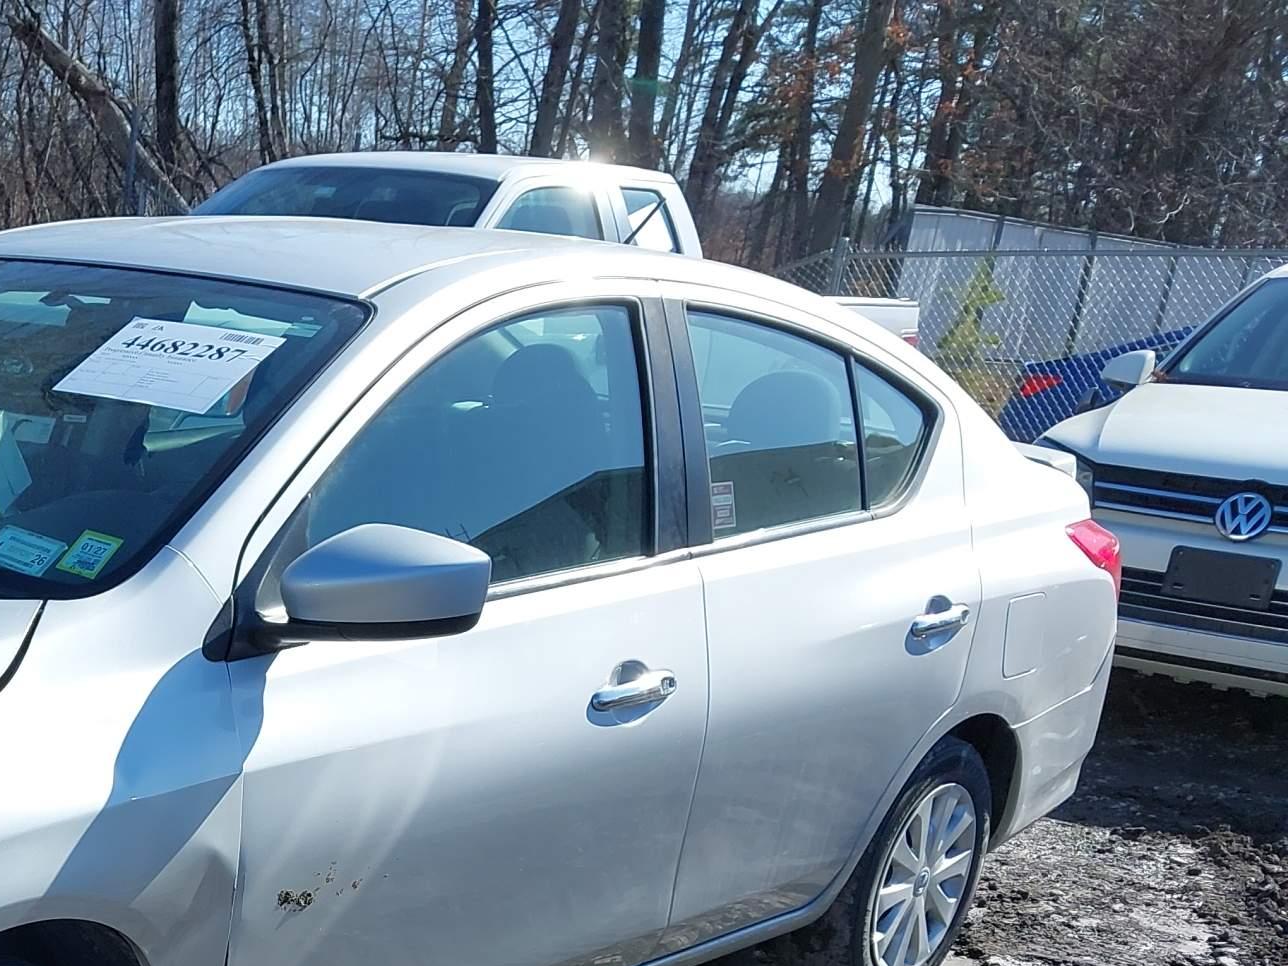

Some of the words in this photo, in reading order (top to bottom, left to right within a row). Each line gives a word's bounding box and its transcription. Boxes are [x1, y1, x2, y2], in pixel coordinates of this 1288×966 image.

[122, 335, 249, 363] 44682287
[1220, 493, 1268, 538] VW
[30, 553, 48, 566] 26
